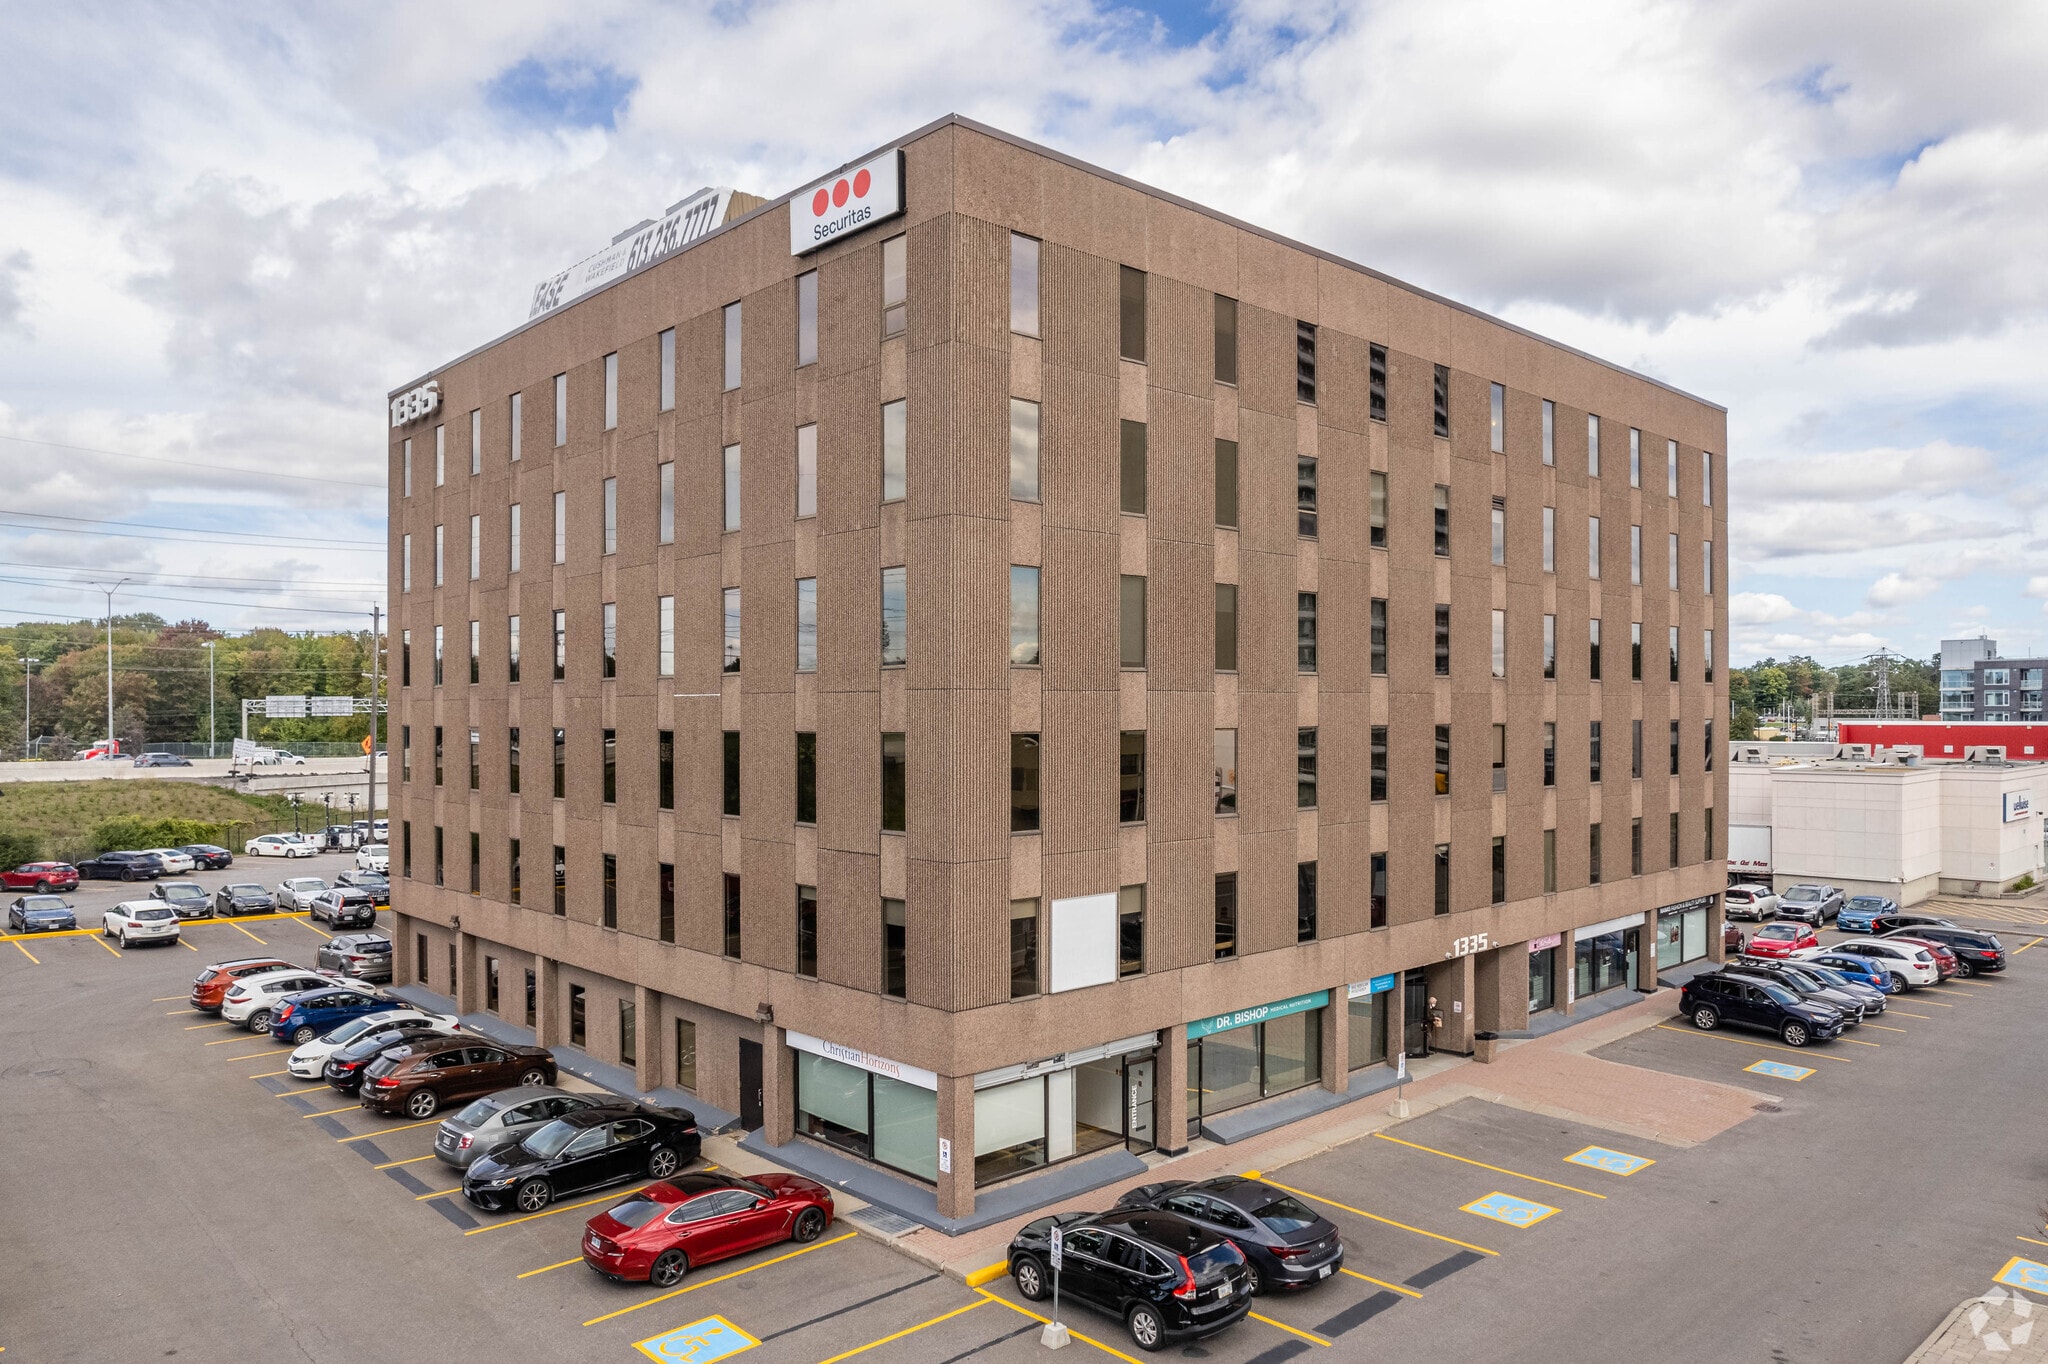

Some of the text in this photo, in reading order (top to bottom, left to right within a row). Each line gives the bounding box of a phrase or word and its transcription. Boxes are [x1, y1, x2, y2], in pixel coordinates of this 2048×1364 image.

[814, 206, 871, 240] Securitas
[585, 258, 625, 283] WAKEFIELD
[588, 250, 621, 273] CUSHMAN
[1453, 932, 1488, 957] 1335
[1216, 999, 1312, 1029] DR. BISHOP MEDICAL NUTRITION
